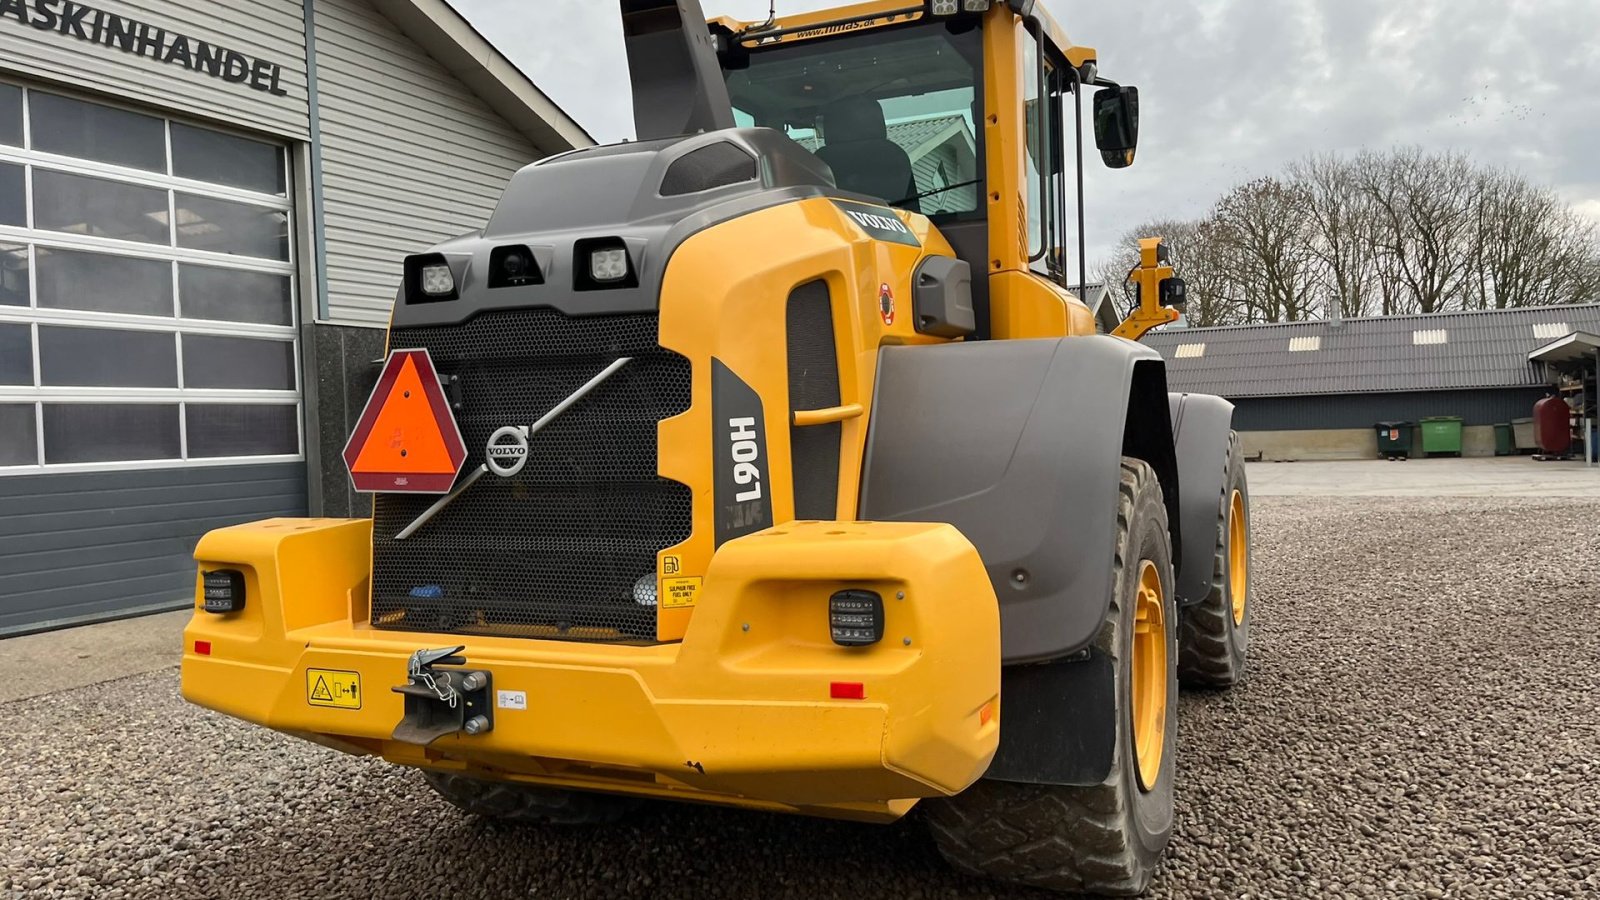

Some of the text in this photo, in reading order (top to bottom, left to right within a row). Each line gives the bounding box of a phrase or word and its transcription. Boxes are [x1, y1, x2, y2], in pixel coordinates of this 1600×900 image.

[846, 210, 907, 234] VOLVO
[488, 447, 526, 456] VOLVO
[729, 416, 762, 502] L90H
